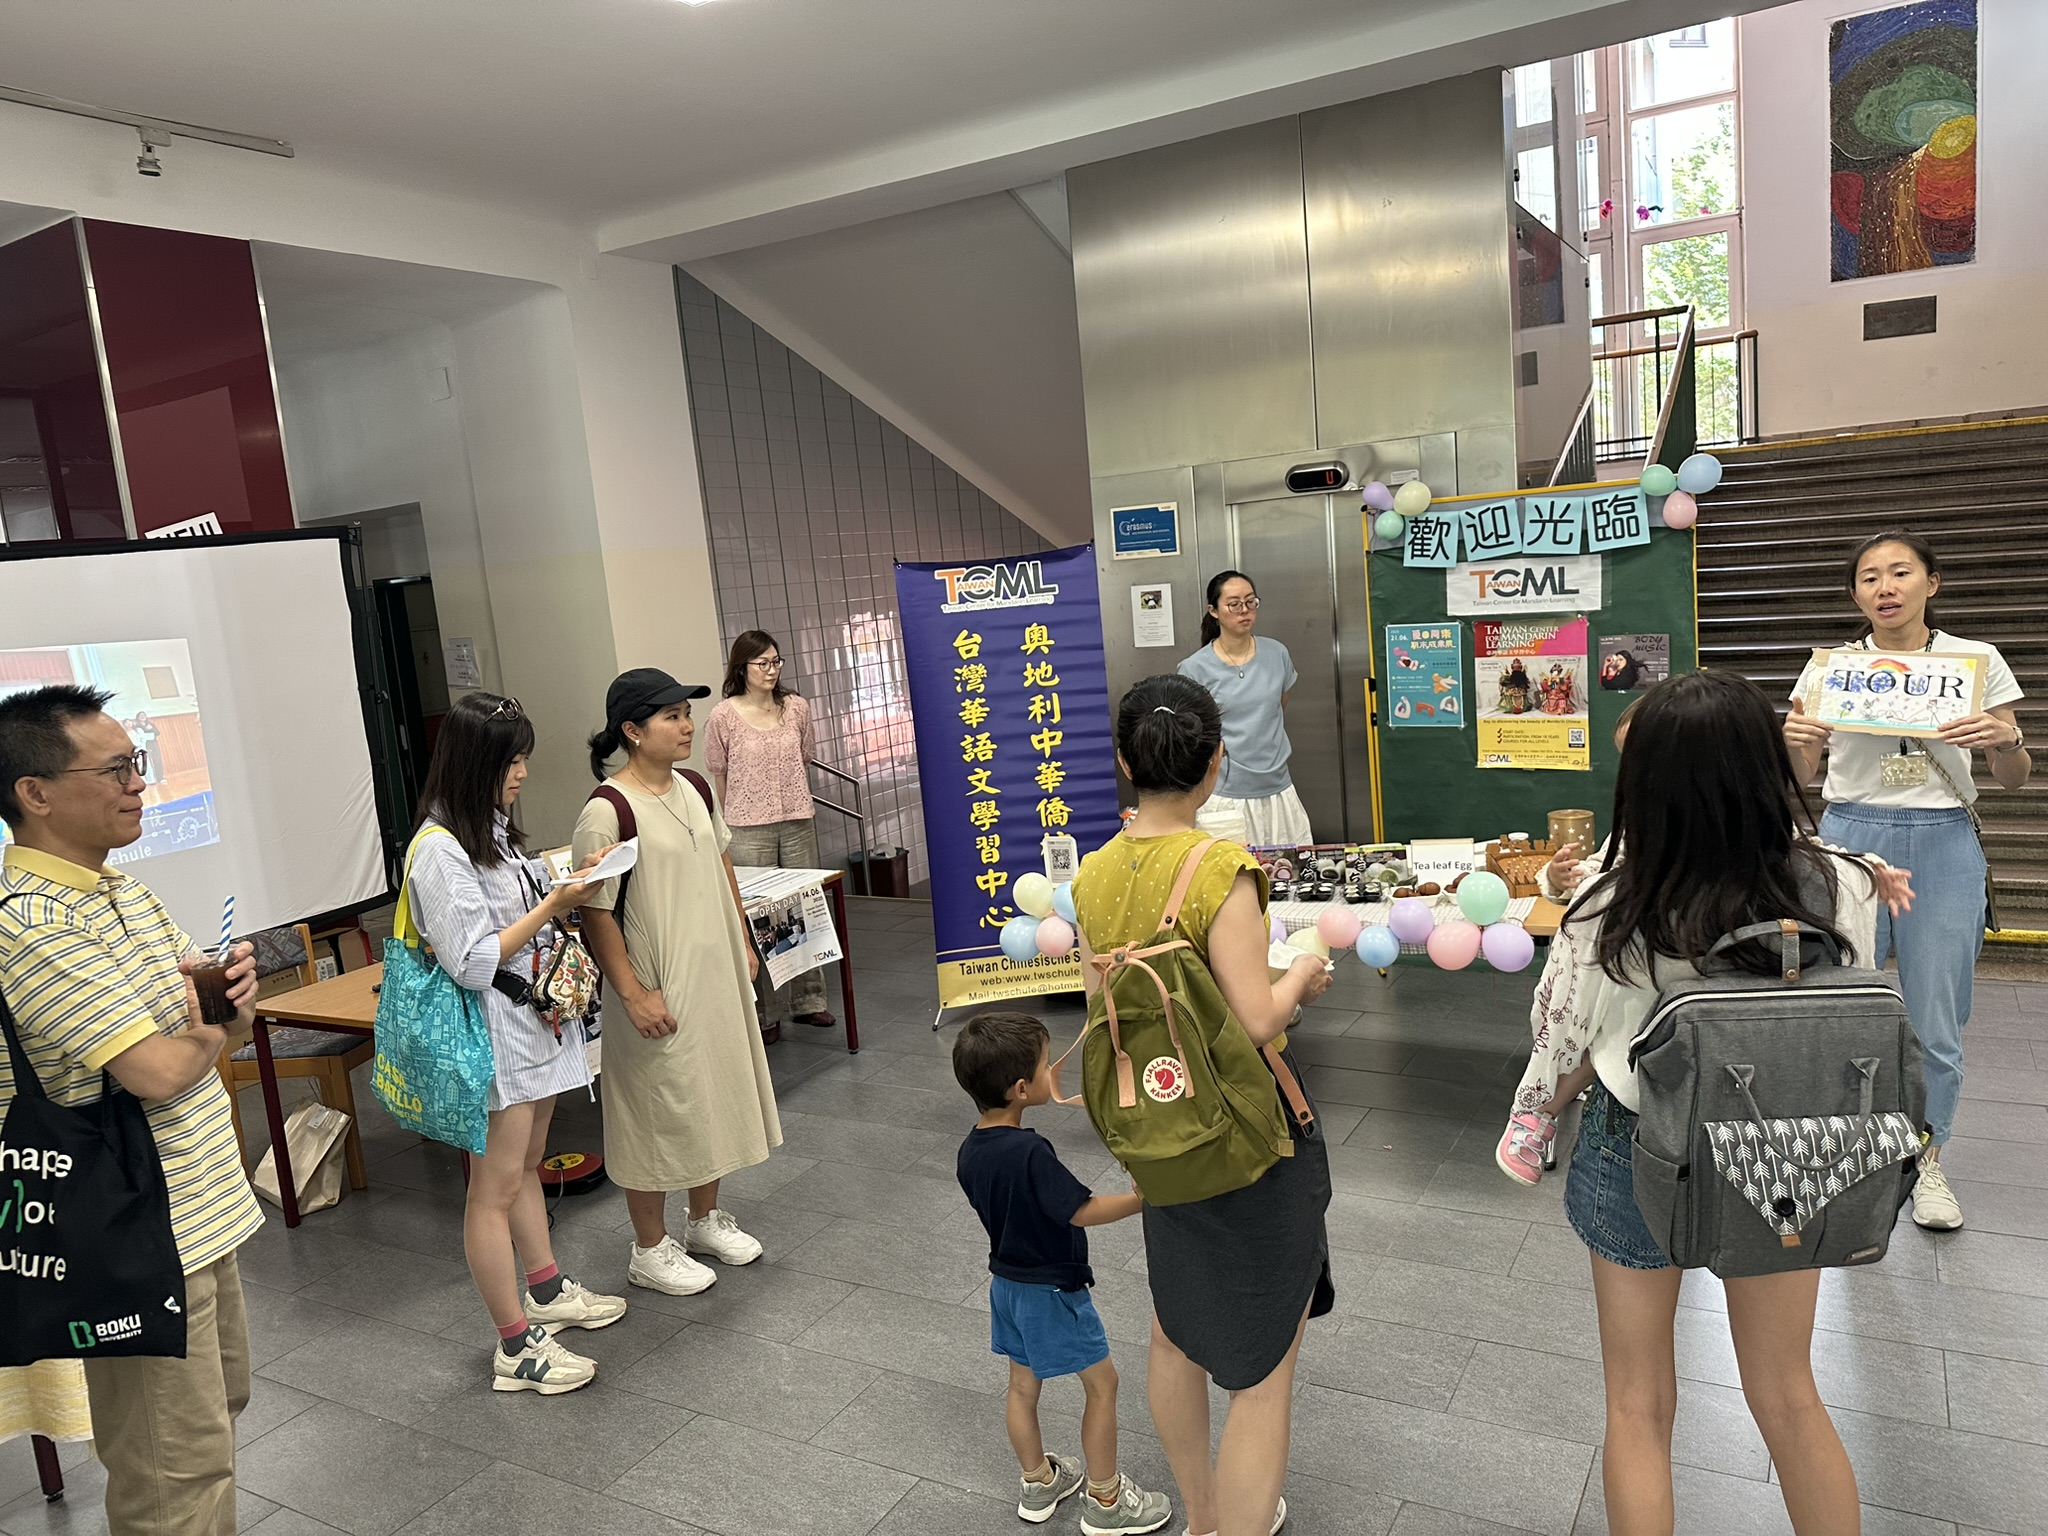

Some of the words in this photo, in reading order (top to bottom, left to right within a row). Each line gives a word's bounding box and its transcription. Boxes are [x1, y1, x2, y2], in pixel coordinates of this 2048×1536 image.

[1407, 493, 1641, 560] 歡迎光臨
[1484, 625, 1527, 635] TAIWAN
[1500, 632, 1556, 641] MANDARIN
[1486, 640, 1535, 649] LEARNING
[1632, 644, 1666, 653] MUSIC
[1832, 669, 1967, 699] TOUR
[1020, 622, 1073, 856] 奧地利中華僑
[952, 629, 1014, 928] 台灣華語文學習中心
[109, 845, 152, 866] chule
[1413, 862, 1430, 870] Tea
[1433, 861, 1452, 869] leaf
[1455, 861, 1473, 871] Egg
[759, 902, 781, 917] OPEN
[783, 894, 799, 908] DAY
[959, 961, 999, 976] Taiwan
[376, 1053, 408, 1091] CASA
[0, 1141, 73, 1180] hape
[95, 1314, 142, 1337] BOKU
[99, 1329, 142, 1343] UNIVERSITY
